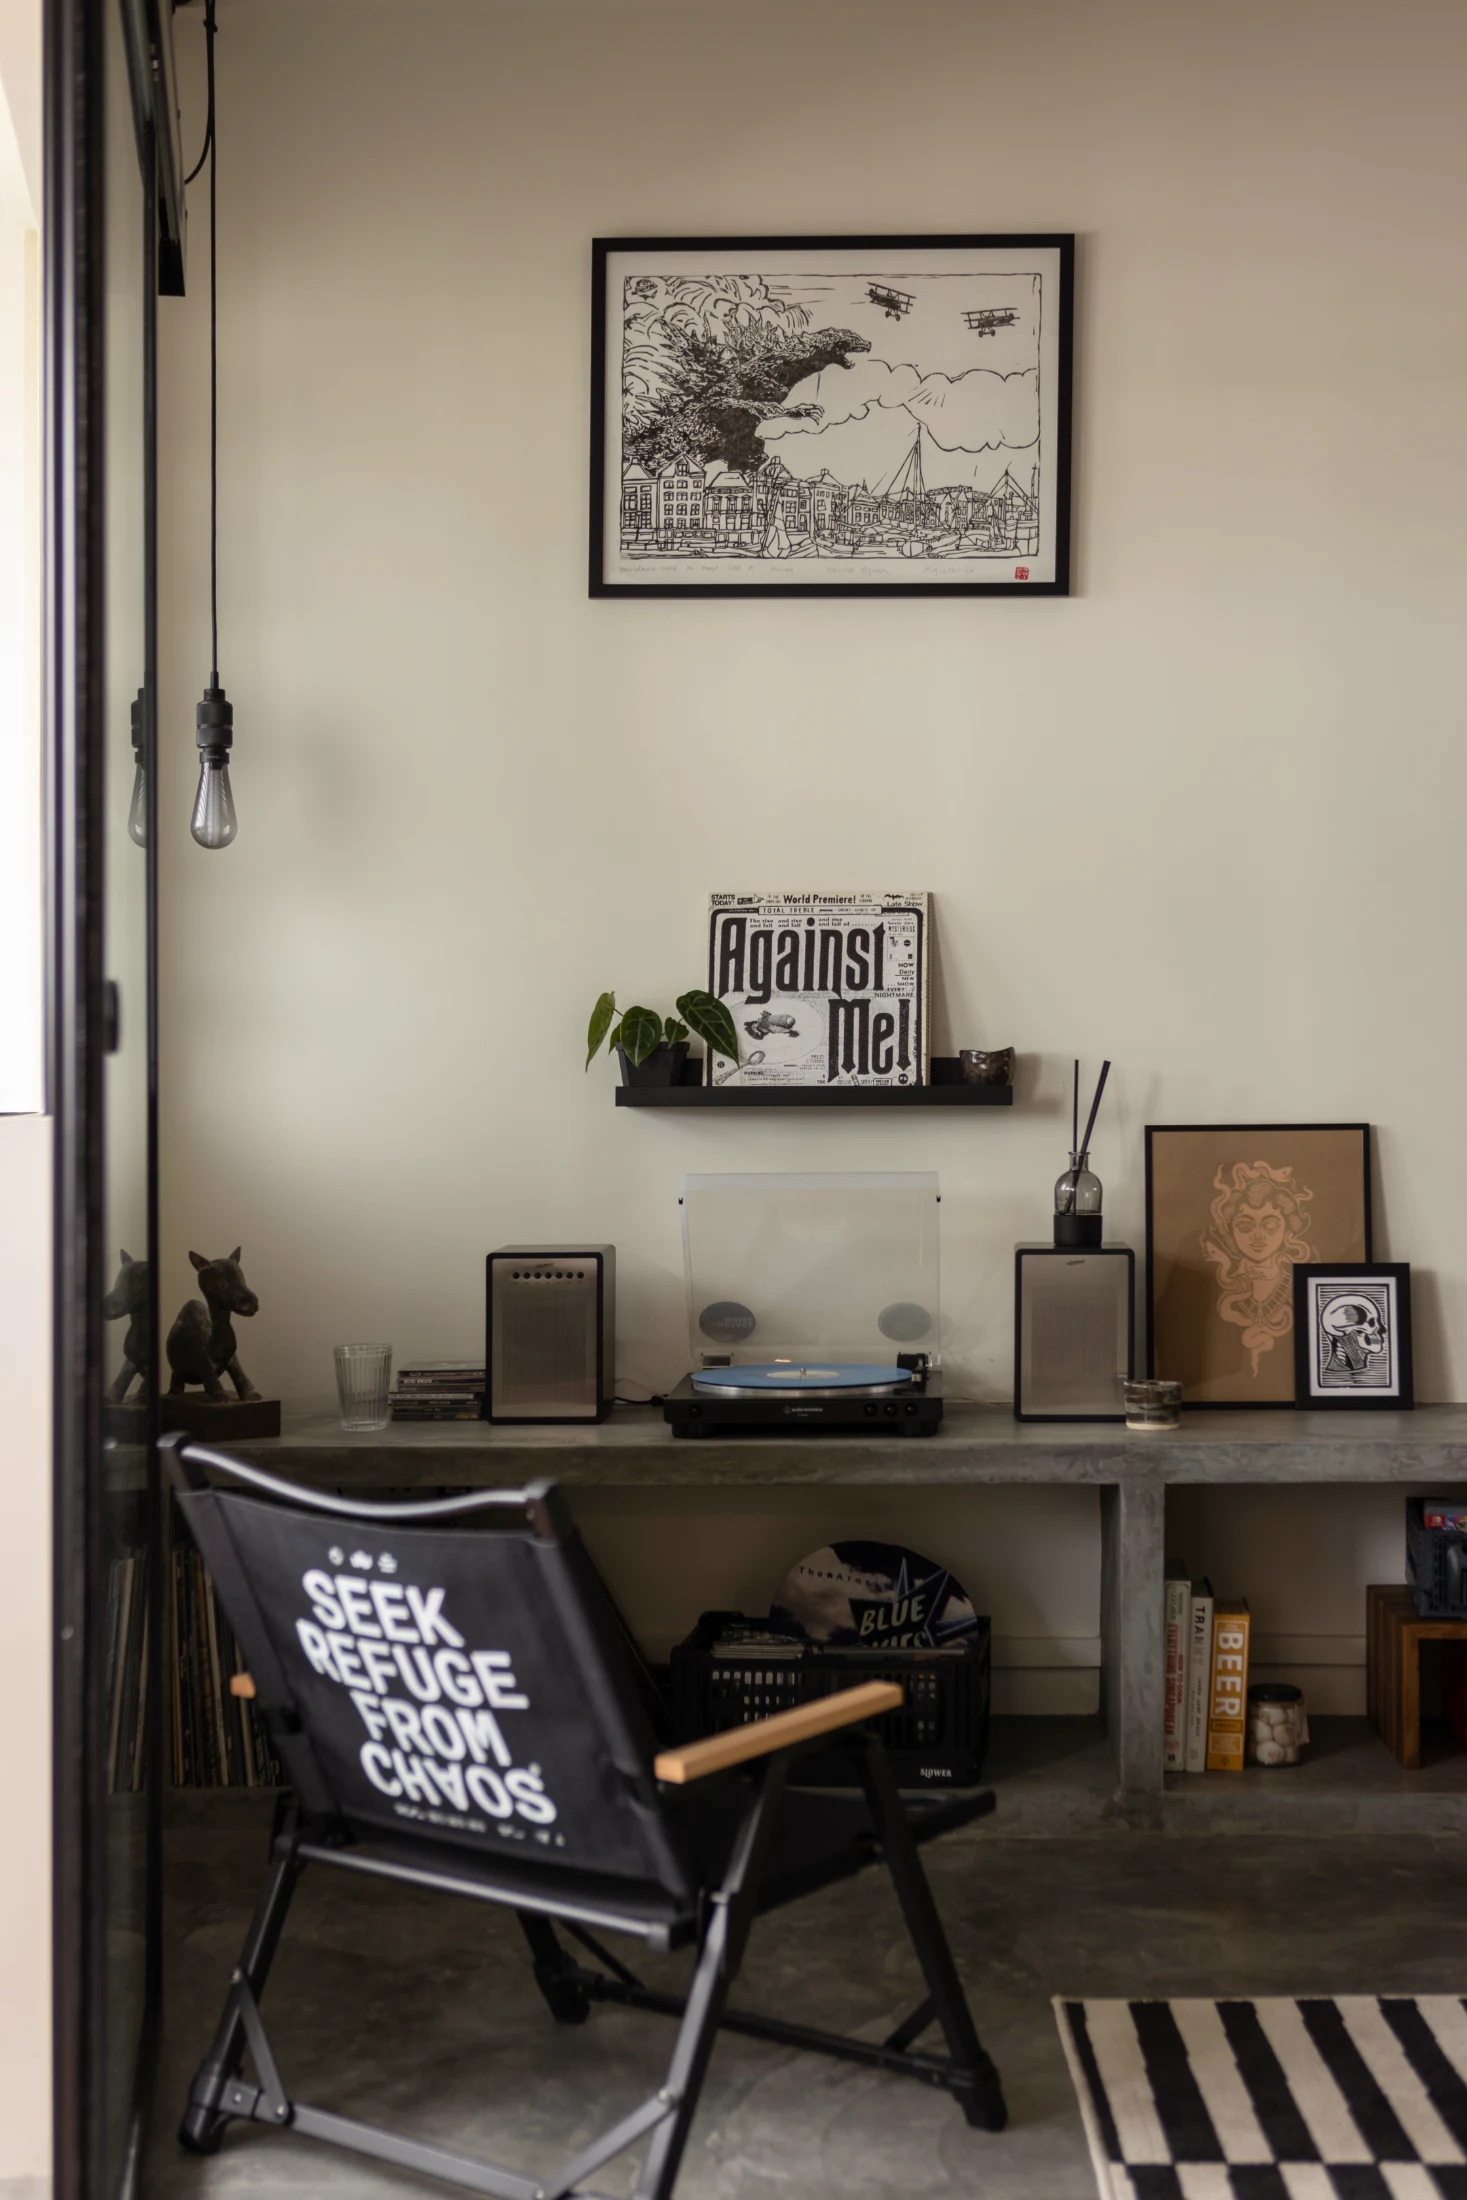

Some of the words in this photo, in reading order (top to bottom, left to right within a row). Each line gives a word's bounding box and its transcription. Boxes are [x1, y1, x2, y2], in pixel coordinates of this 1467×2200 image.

[783, 894, 811, 904] World
[813, 894, 856, 904] Premiere!
[717, 917, 886, 1005] Against
[828, 998, 911, 1084] Me!
[302, 1569, 465, 1648] SEEK
[800, 1566, 823, 1578] The
[860, 1594, 926, 1637] BLUE
[295, 1618, 530, 1710] REFUGE
[1215, 1632, 1244, 1716] BEER
[350, 1689, 512, 1767] FROM
[360, 1740, 557, 1824] CHAOS
[920, 1767, 952, 1779] SLOWER
